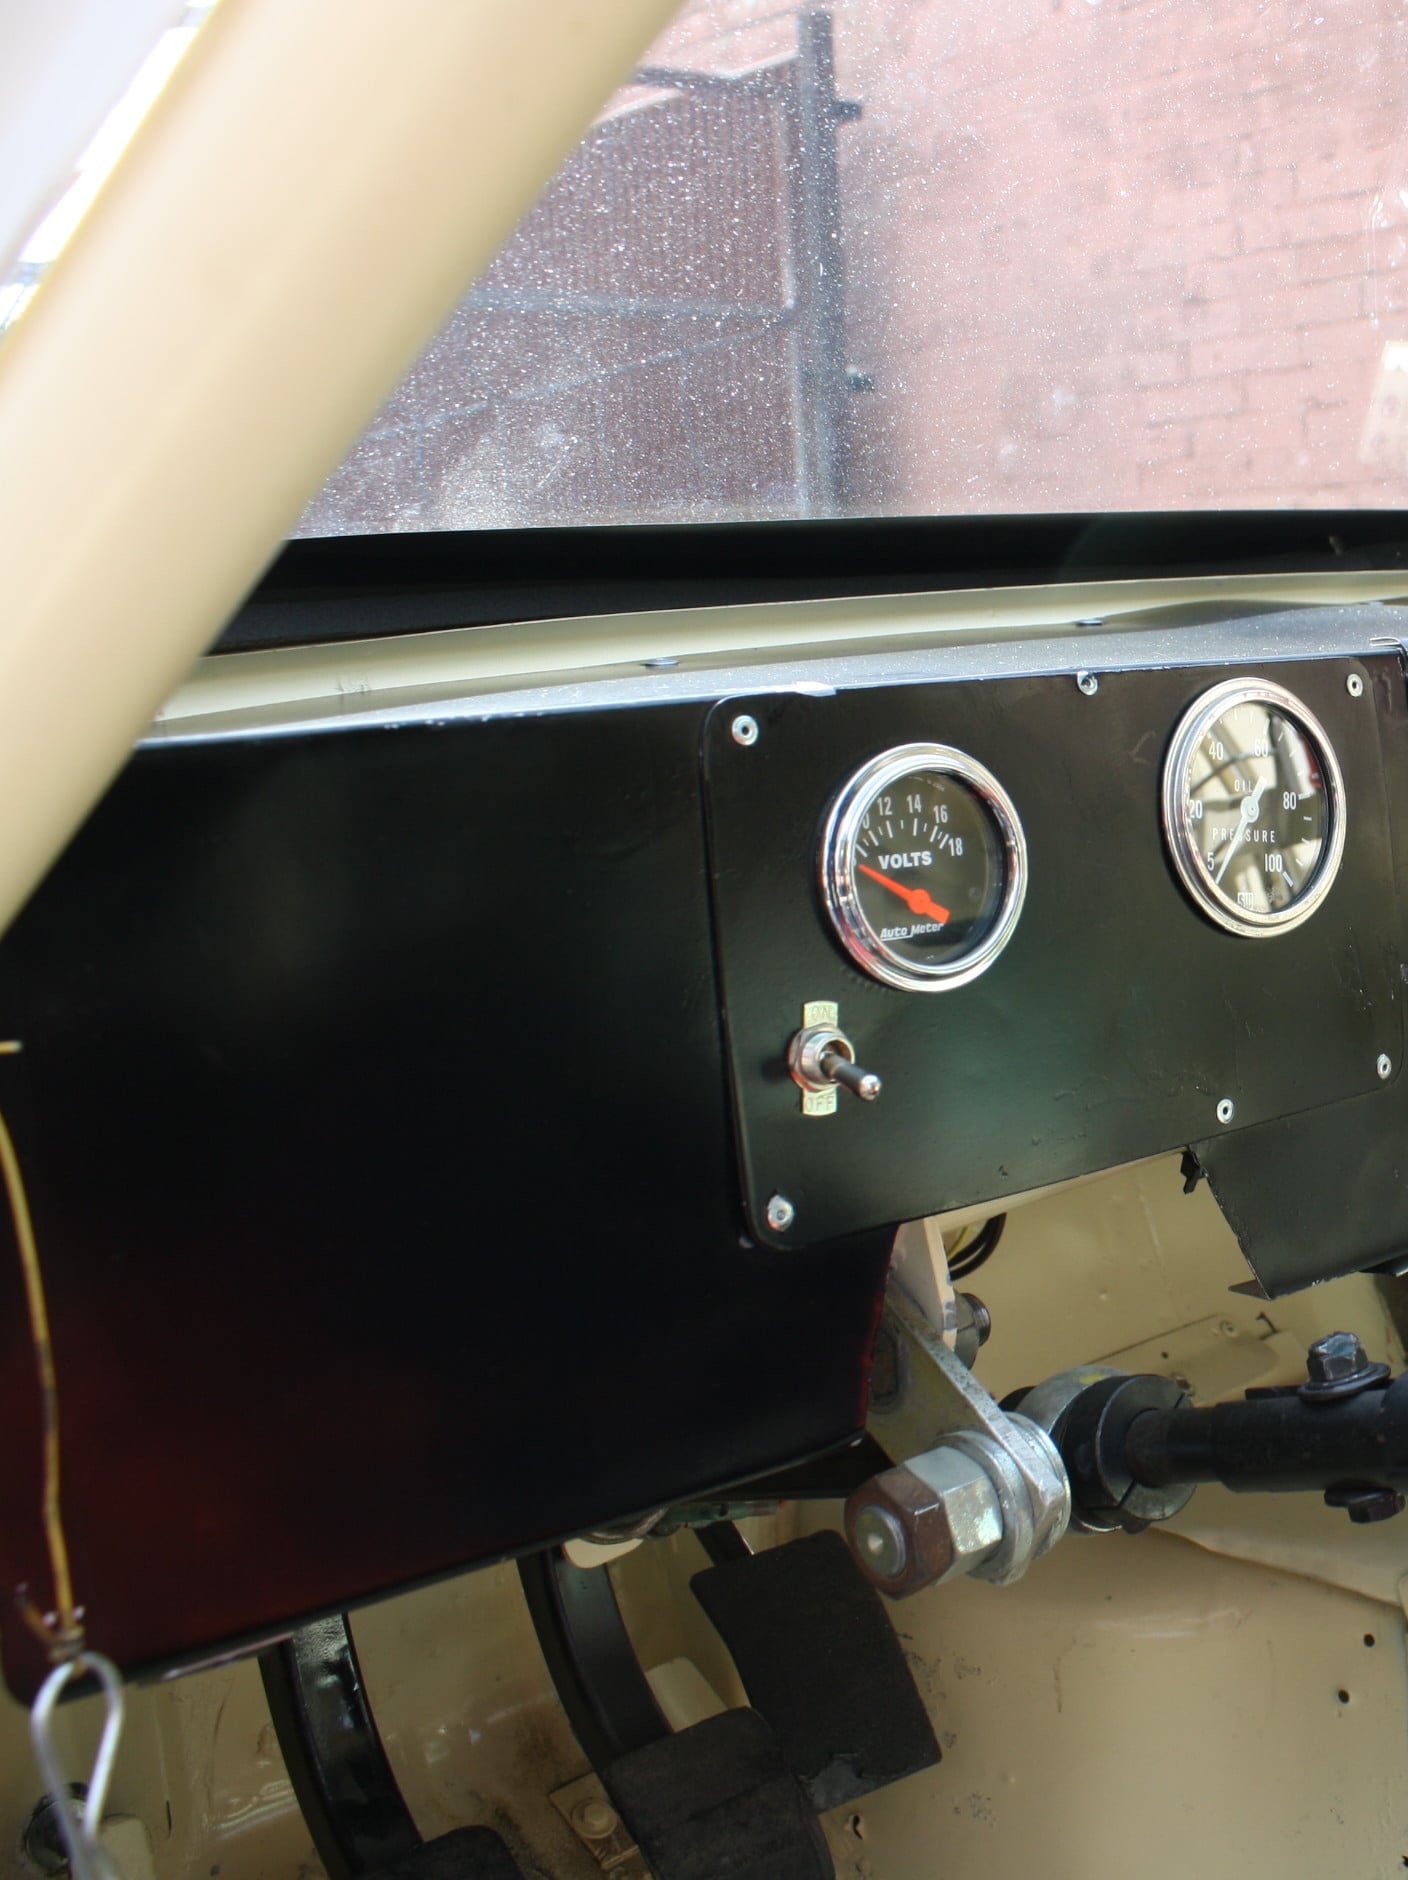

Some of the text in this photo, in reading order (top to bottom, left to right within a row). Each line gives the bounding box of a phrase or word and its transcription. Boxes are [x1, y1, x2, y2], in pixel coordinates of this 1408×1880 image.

[1208, 742, 1224, 760] 40
[1254, 738, 1269, 758] 60
[1234, 779, 1254, 793] OIL
[877, 796, 893, 816] 12
[906, 793, 922, 814] 14
[1189, 800, 1203, 819] 20
[1283, 792, 1297, 811] 80
[933, 804, 949, 824] 16
[1212, 828, 1276, 844] PRESURE
[949, 837, 963, 857] 18
[878, 850, 933, 870] VOLTS
[1207, 852, 1215, 871] 5
[1264, 853, 1283, 873] 100
[880, 921, 945, 941] Auto Meter
